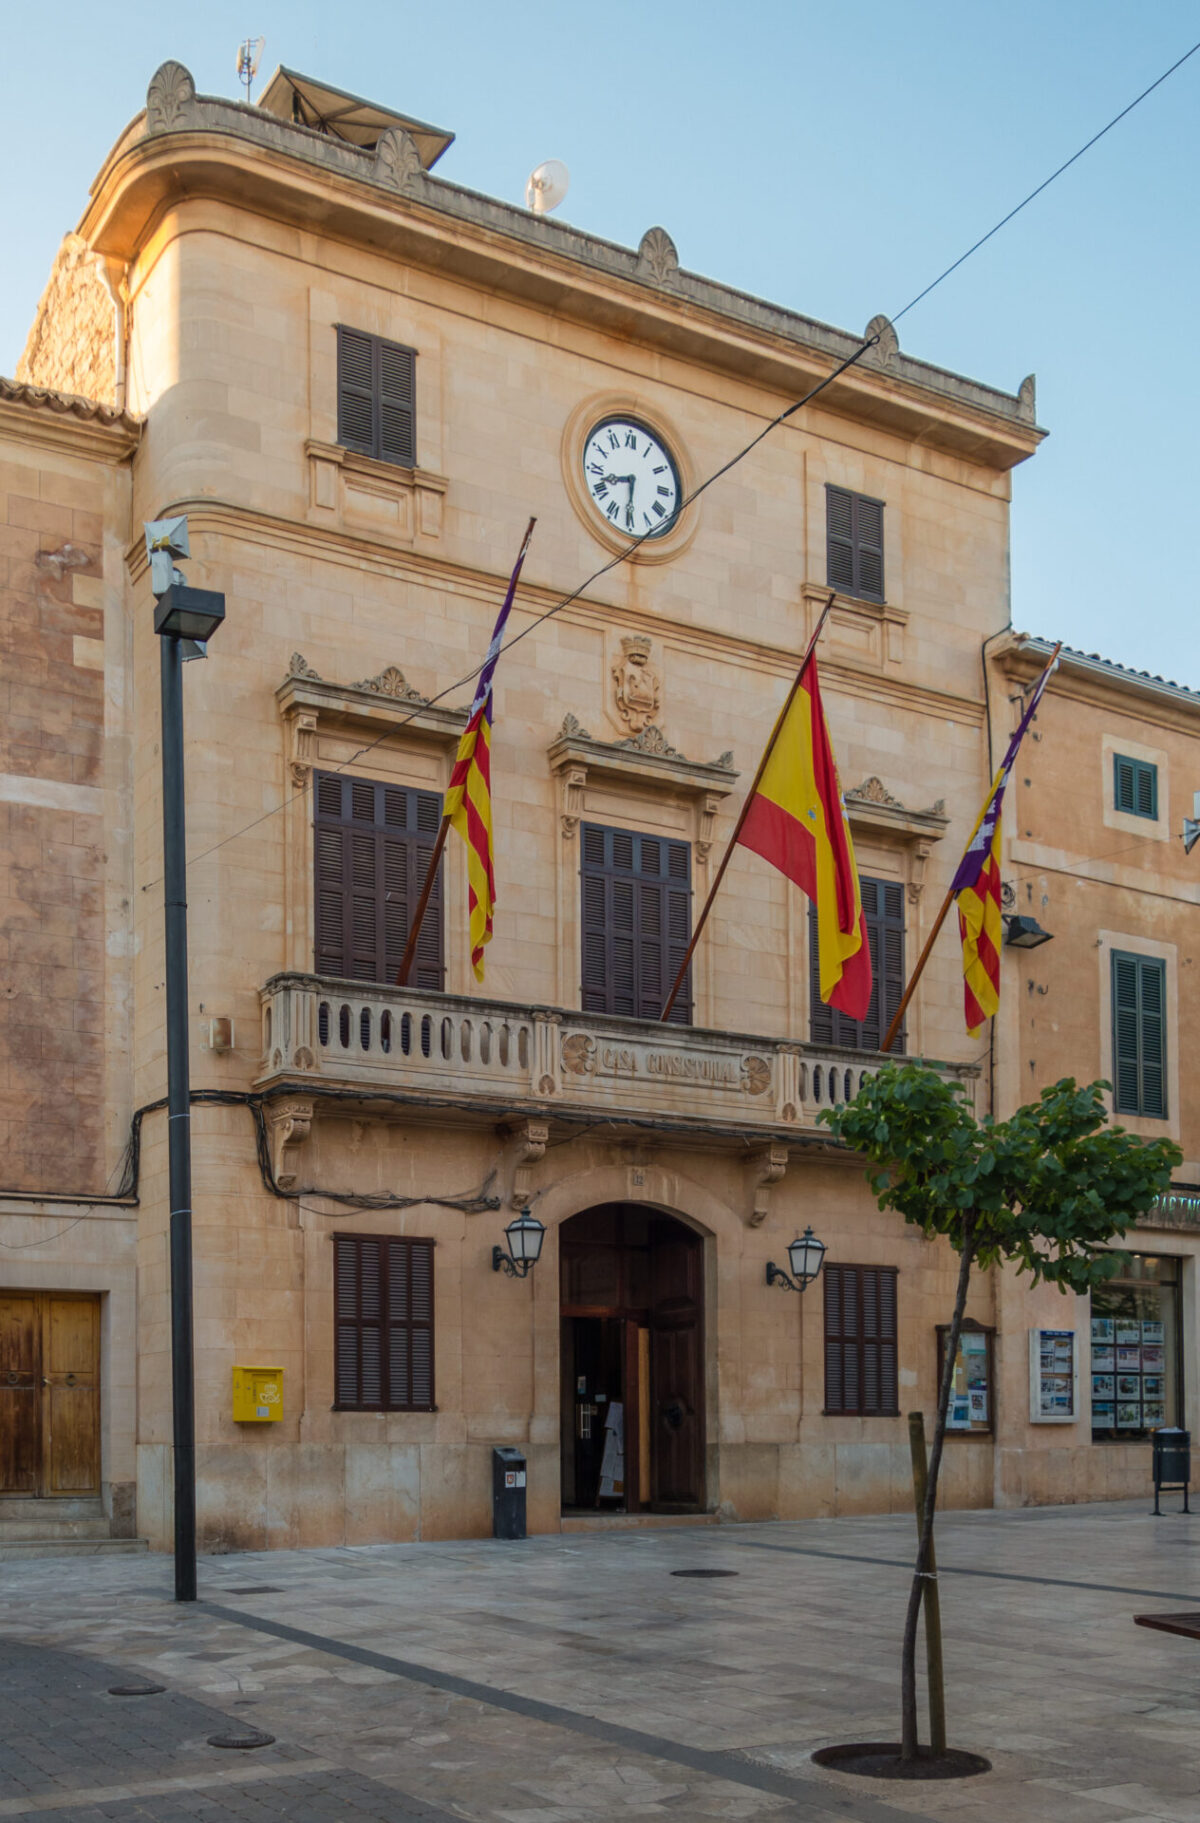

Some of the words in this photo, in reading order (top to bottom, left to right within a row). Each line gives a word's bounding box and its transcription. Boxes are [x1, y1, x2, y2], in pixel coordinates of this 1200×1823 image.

[595, 445, 609, 459] X
[603, 1048, 638, 1071] CASA
[646, 1053, 738, 1083] CONSISTORIAL
